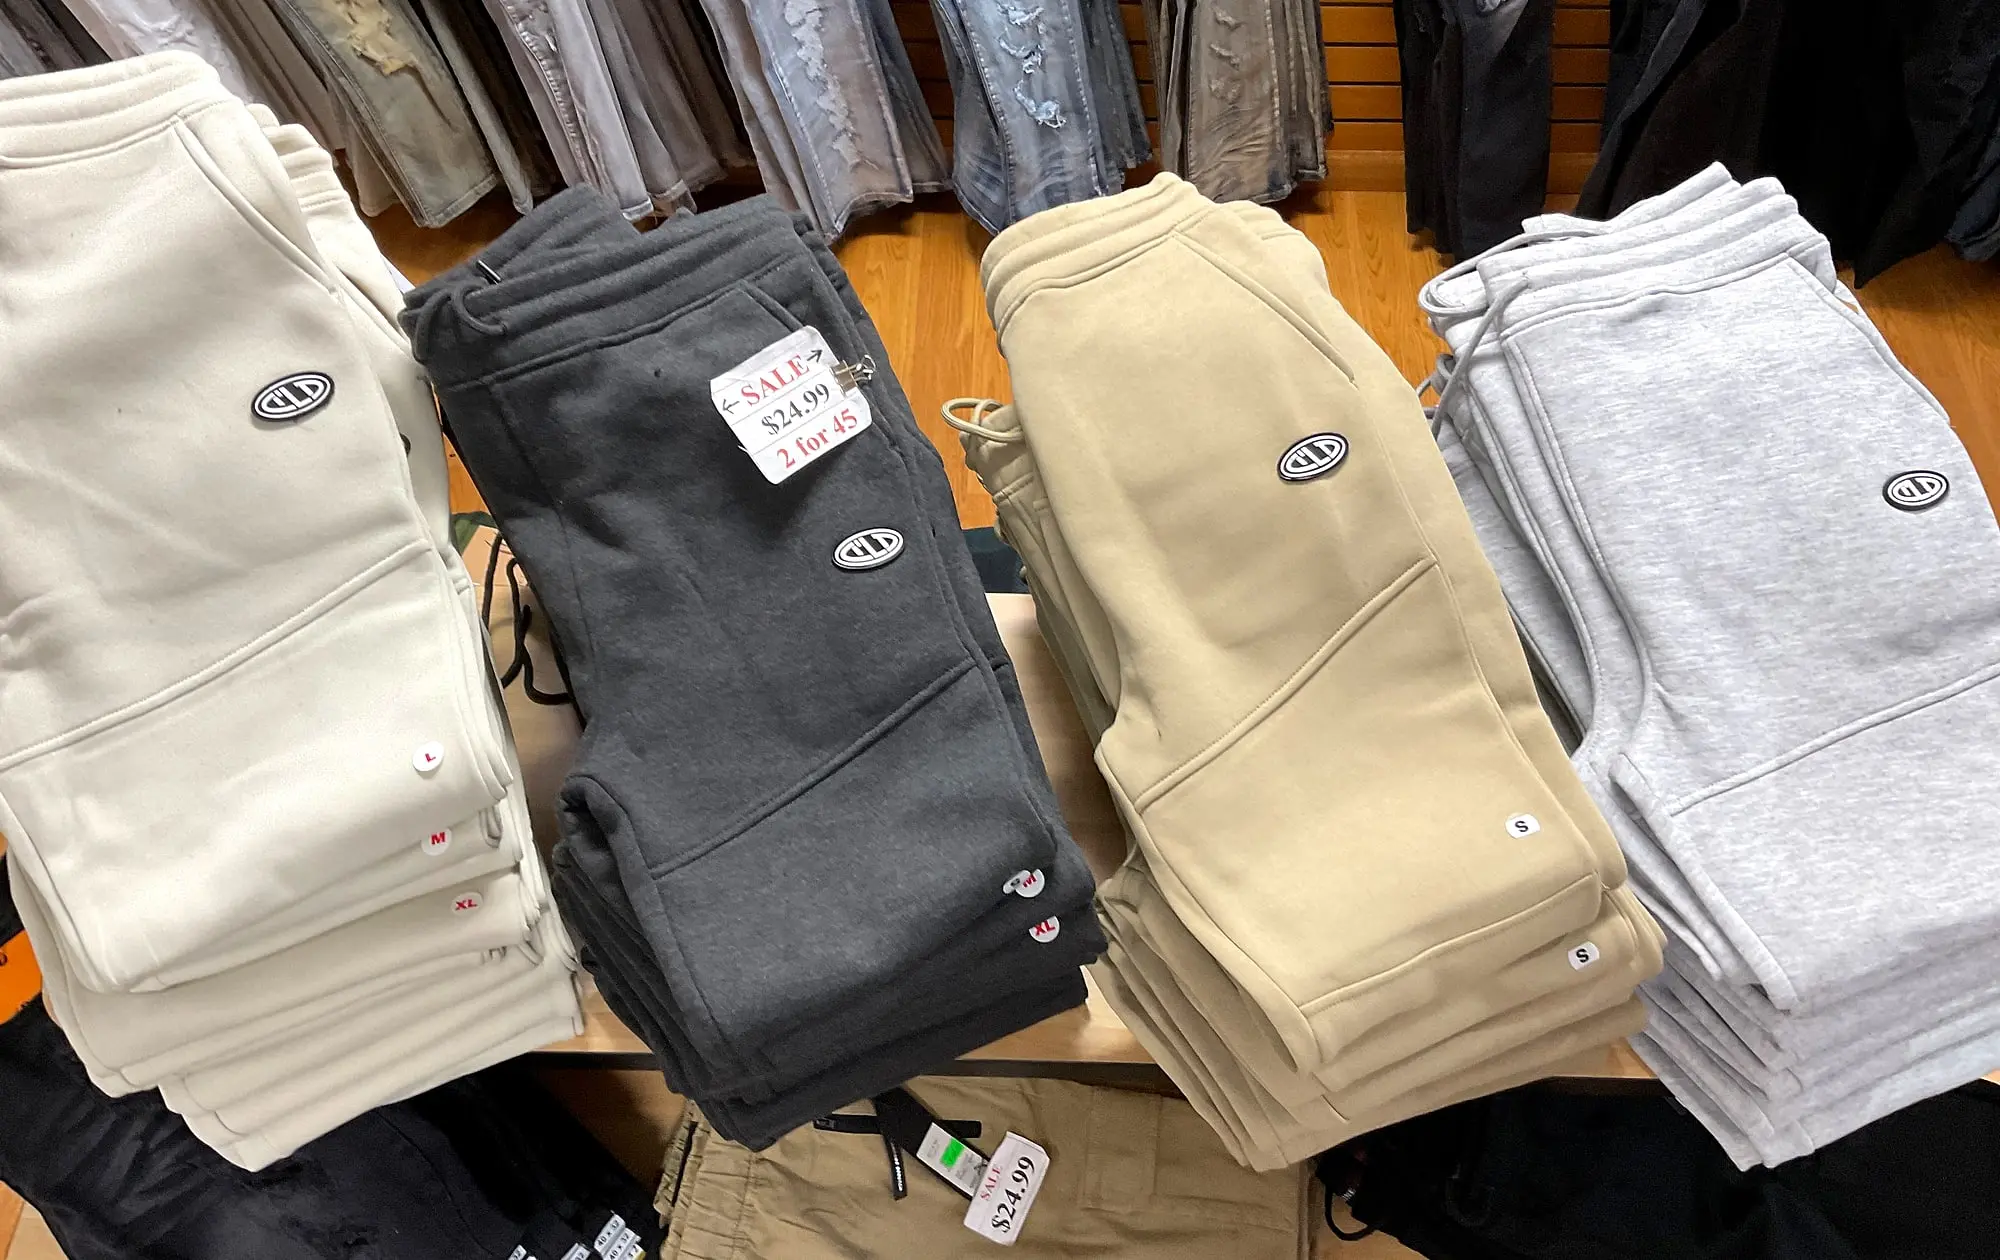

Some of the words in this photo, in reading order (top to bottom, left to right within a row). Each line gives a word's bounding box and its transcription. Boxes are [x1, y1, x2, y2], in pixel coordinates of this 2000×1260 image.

[741, 355, 810, 406] SALE
[761, 383, 830, 436] $24.99
[776, 448, 796, 469] 2
[795, 428, 828, 457] for
[833, 408, 858, 434] 45
[424, 753, 437, 763] L
[1514, 820, 1529, 833] S
[431, 831, 446, 845] M
[455, 898, 478, 911] XL
[1033, 919, 1056, 936] XL
[1575, 948, 1590, 963] S
[980, 1166, 1003, 1200] SALE
[991, 1156, 1035, 1233] $24.99
